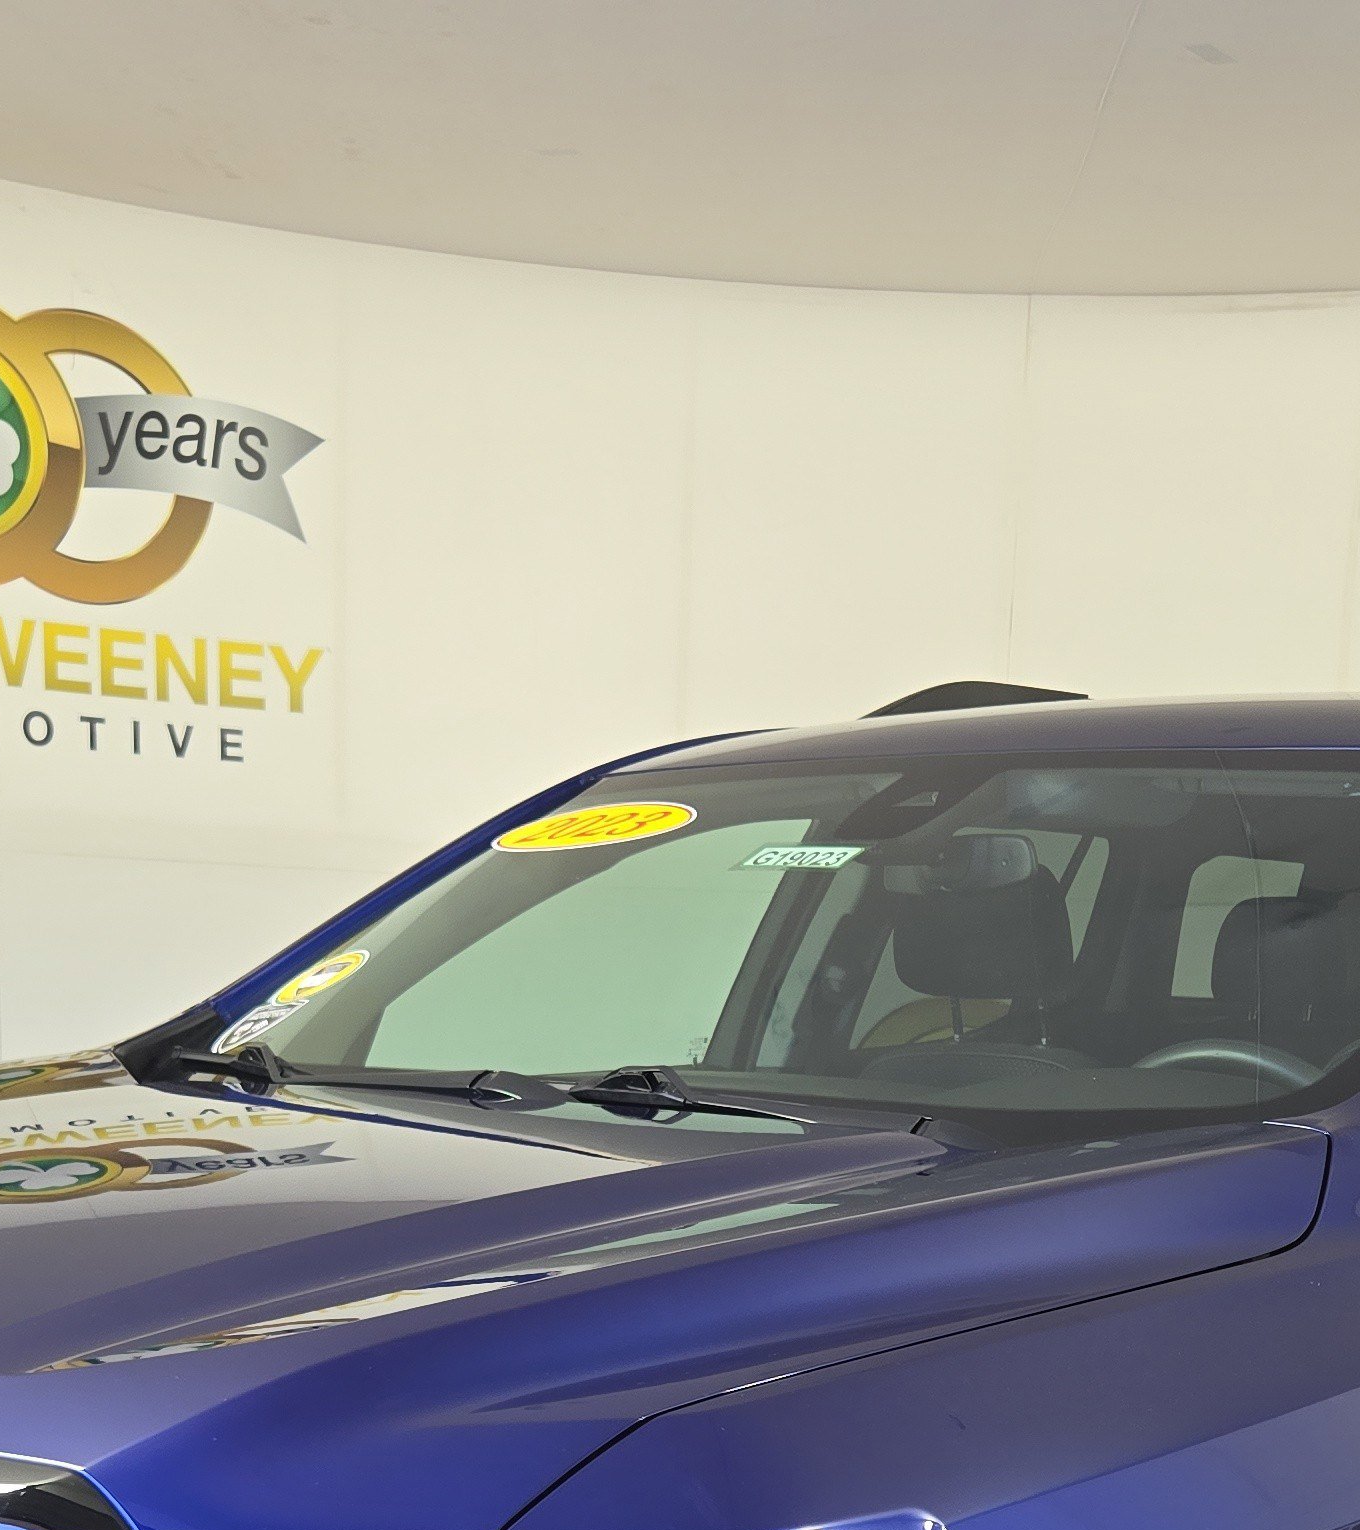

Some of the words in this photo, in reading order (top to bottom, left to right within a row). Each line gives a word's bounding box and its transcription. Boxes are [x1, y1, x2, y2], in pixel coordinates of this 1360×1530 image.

[97, 404, 269, 481] years
[514, 811, 672, 843] 2023
[752, 851, 847, 867] G19023
